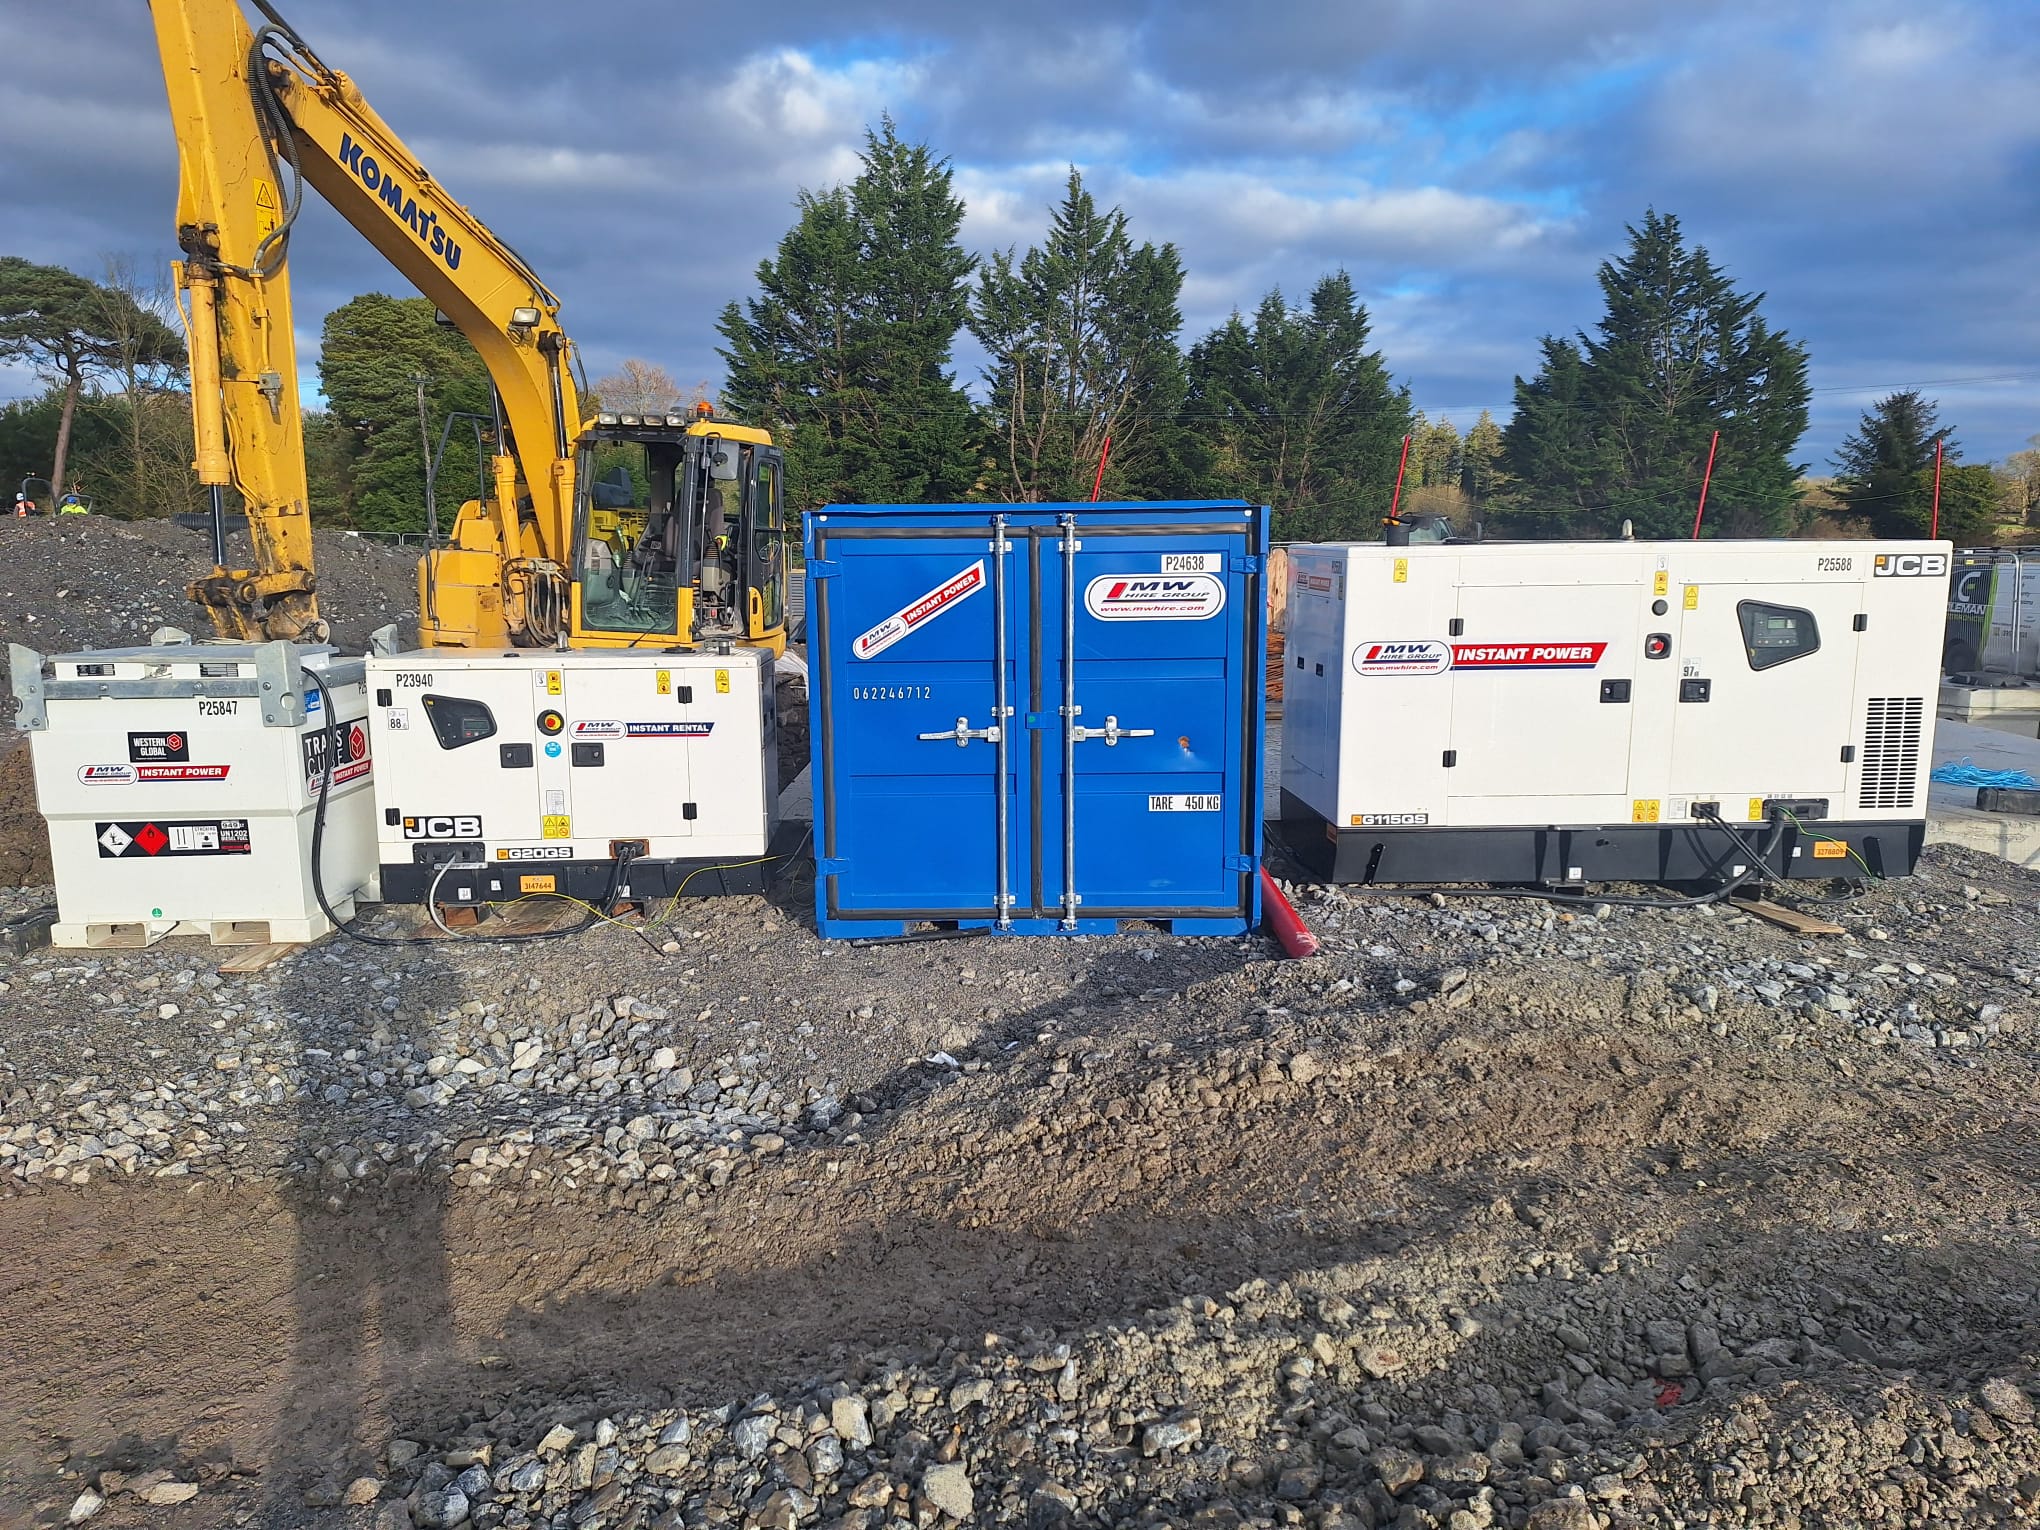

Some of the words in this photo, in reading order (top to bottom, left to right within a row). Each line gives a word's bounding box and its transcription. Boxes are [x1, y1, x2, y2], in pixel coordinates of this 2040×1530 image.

[339, 132, 461, 270] KOMATSU
[1166, 556, 1204, 571] P24638
[1818, 558, 1852, 572] P25588
[1875, 555, 1945, 576] JCB
[1130, 581, 1195, 591] MW
[906, 594, 943, 622] INSTANT
[943, 574, 976, 599] POWER
[1384, 644, 1432, 654] MW
[1456, 648, 1529, 661] INSTANT
[1532, 646, 1593, 660] POWER
[1407, 652, 1443, 660] GROUP
[1683, 666, 1694, 677] 97
[396, 673, 433, 688] P23940
[853, 686, 931, 700] 062246712
[199, 701, 238, 716] P25847
[390, 718, 402, 729] 88
[629, 724, 671, 732] INSTANT
[672, 724, 709, 732] RENTAL
[133, 737, 167, 748] WESTERN
[305, 729, 343, 757] TRAS
[140, 747, 167, 757] GLOBAL
[141, 768, 183, 777] INSTANT
[186, 767, 222, 776] POWER
[1150, 796, 1174, 810] TARE
[1184, 795, 1204, 810] 450
[1206, 795, 1219, 810] KG
[1362, 814, 1427, 825] G115QS
[220, 829, 248, 837] UN1202
[405, 817, 481, 838] JCB
[508, 848, 571, 859] G20QS
